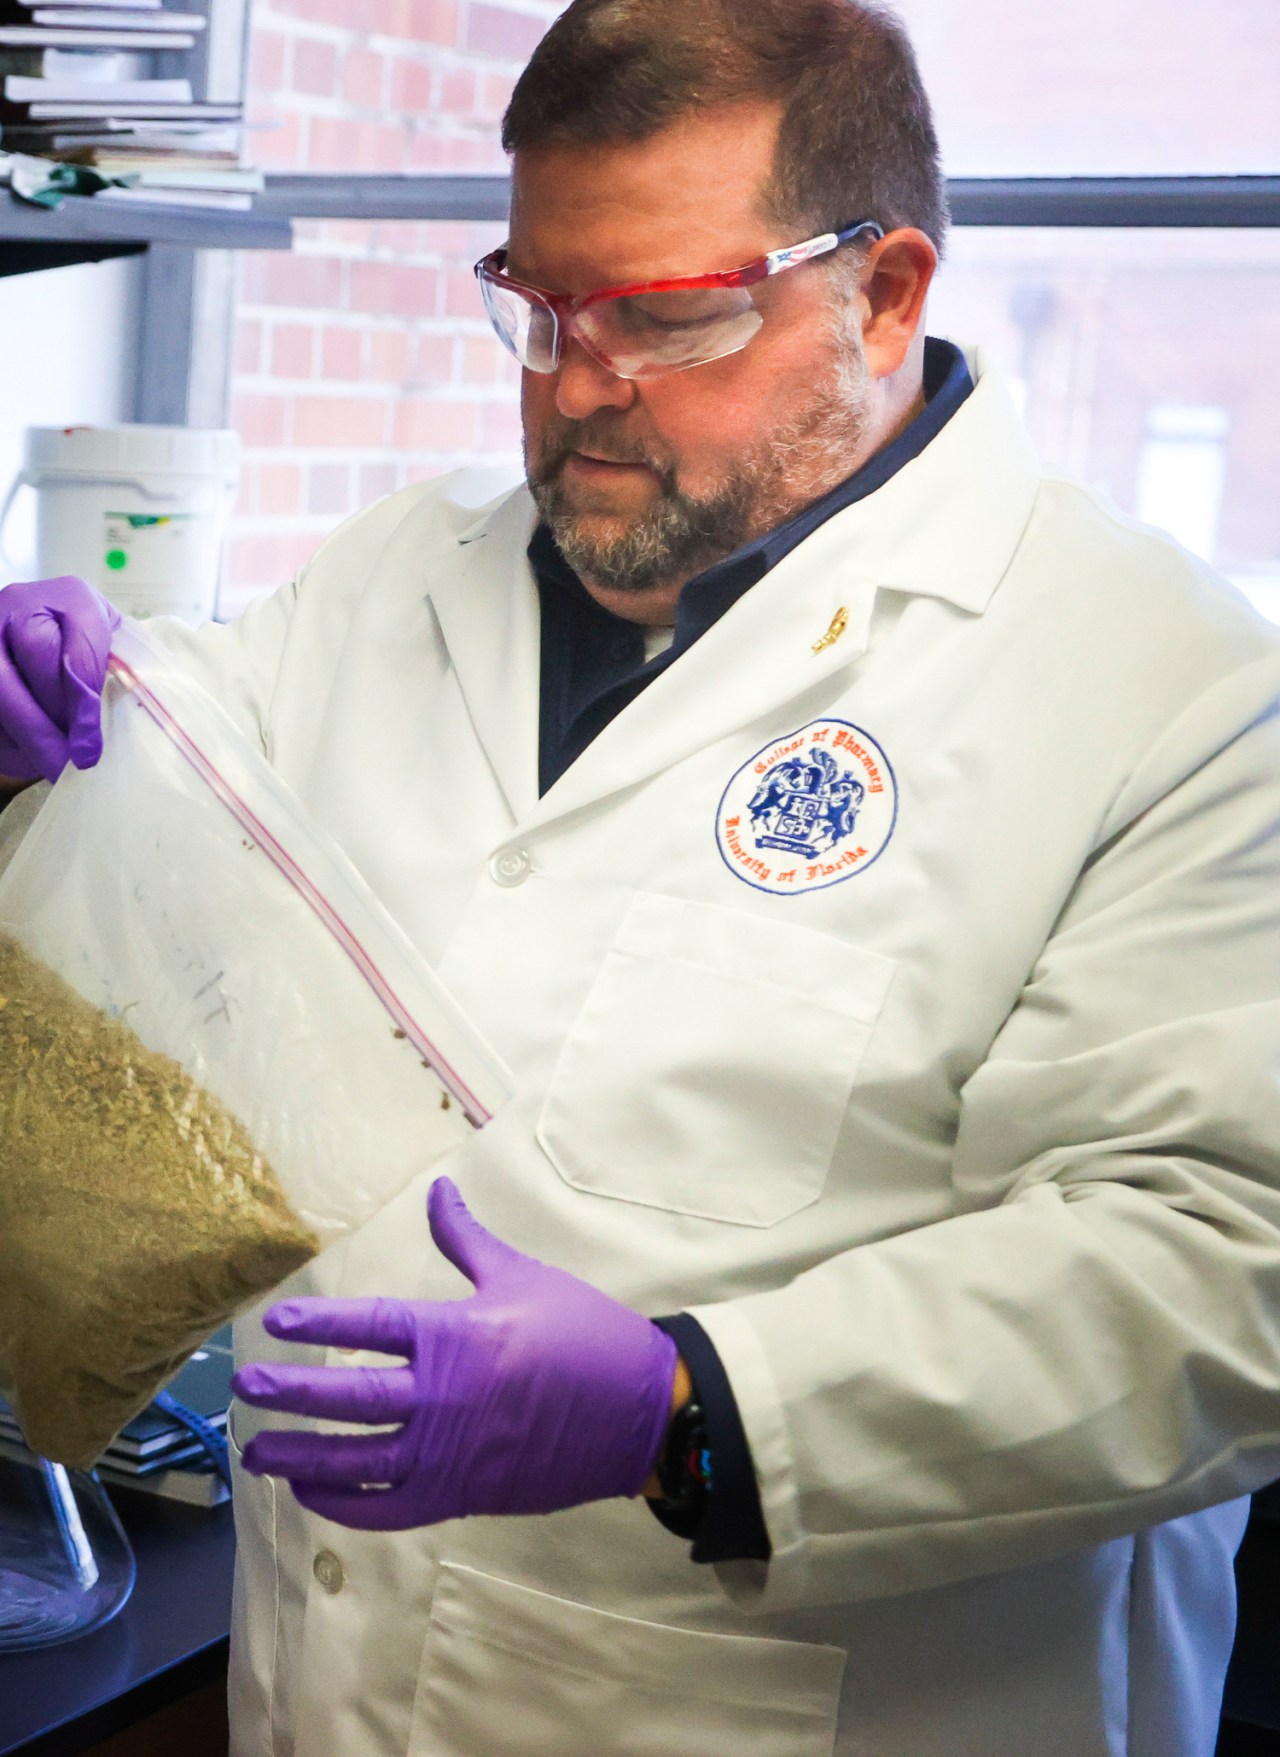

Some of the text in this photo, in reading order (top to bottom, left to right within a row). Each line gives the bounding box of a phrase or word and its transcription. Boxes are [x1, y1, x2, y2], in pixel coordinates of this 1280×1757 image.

[754, 728, 884, 793] College of Pharmacy
[726, 815, 869, 882] University of Florida
